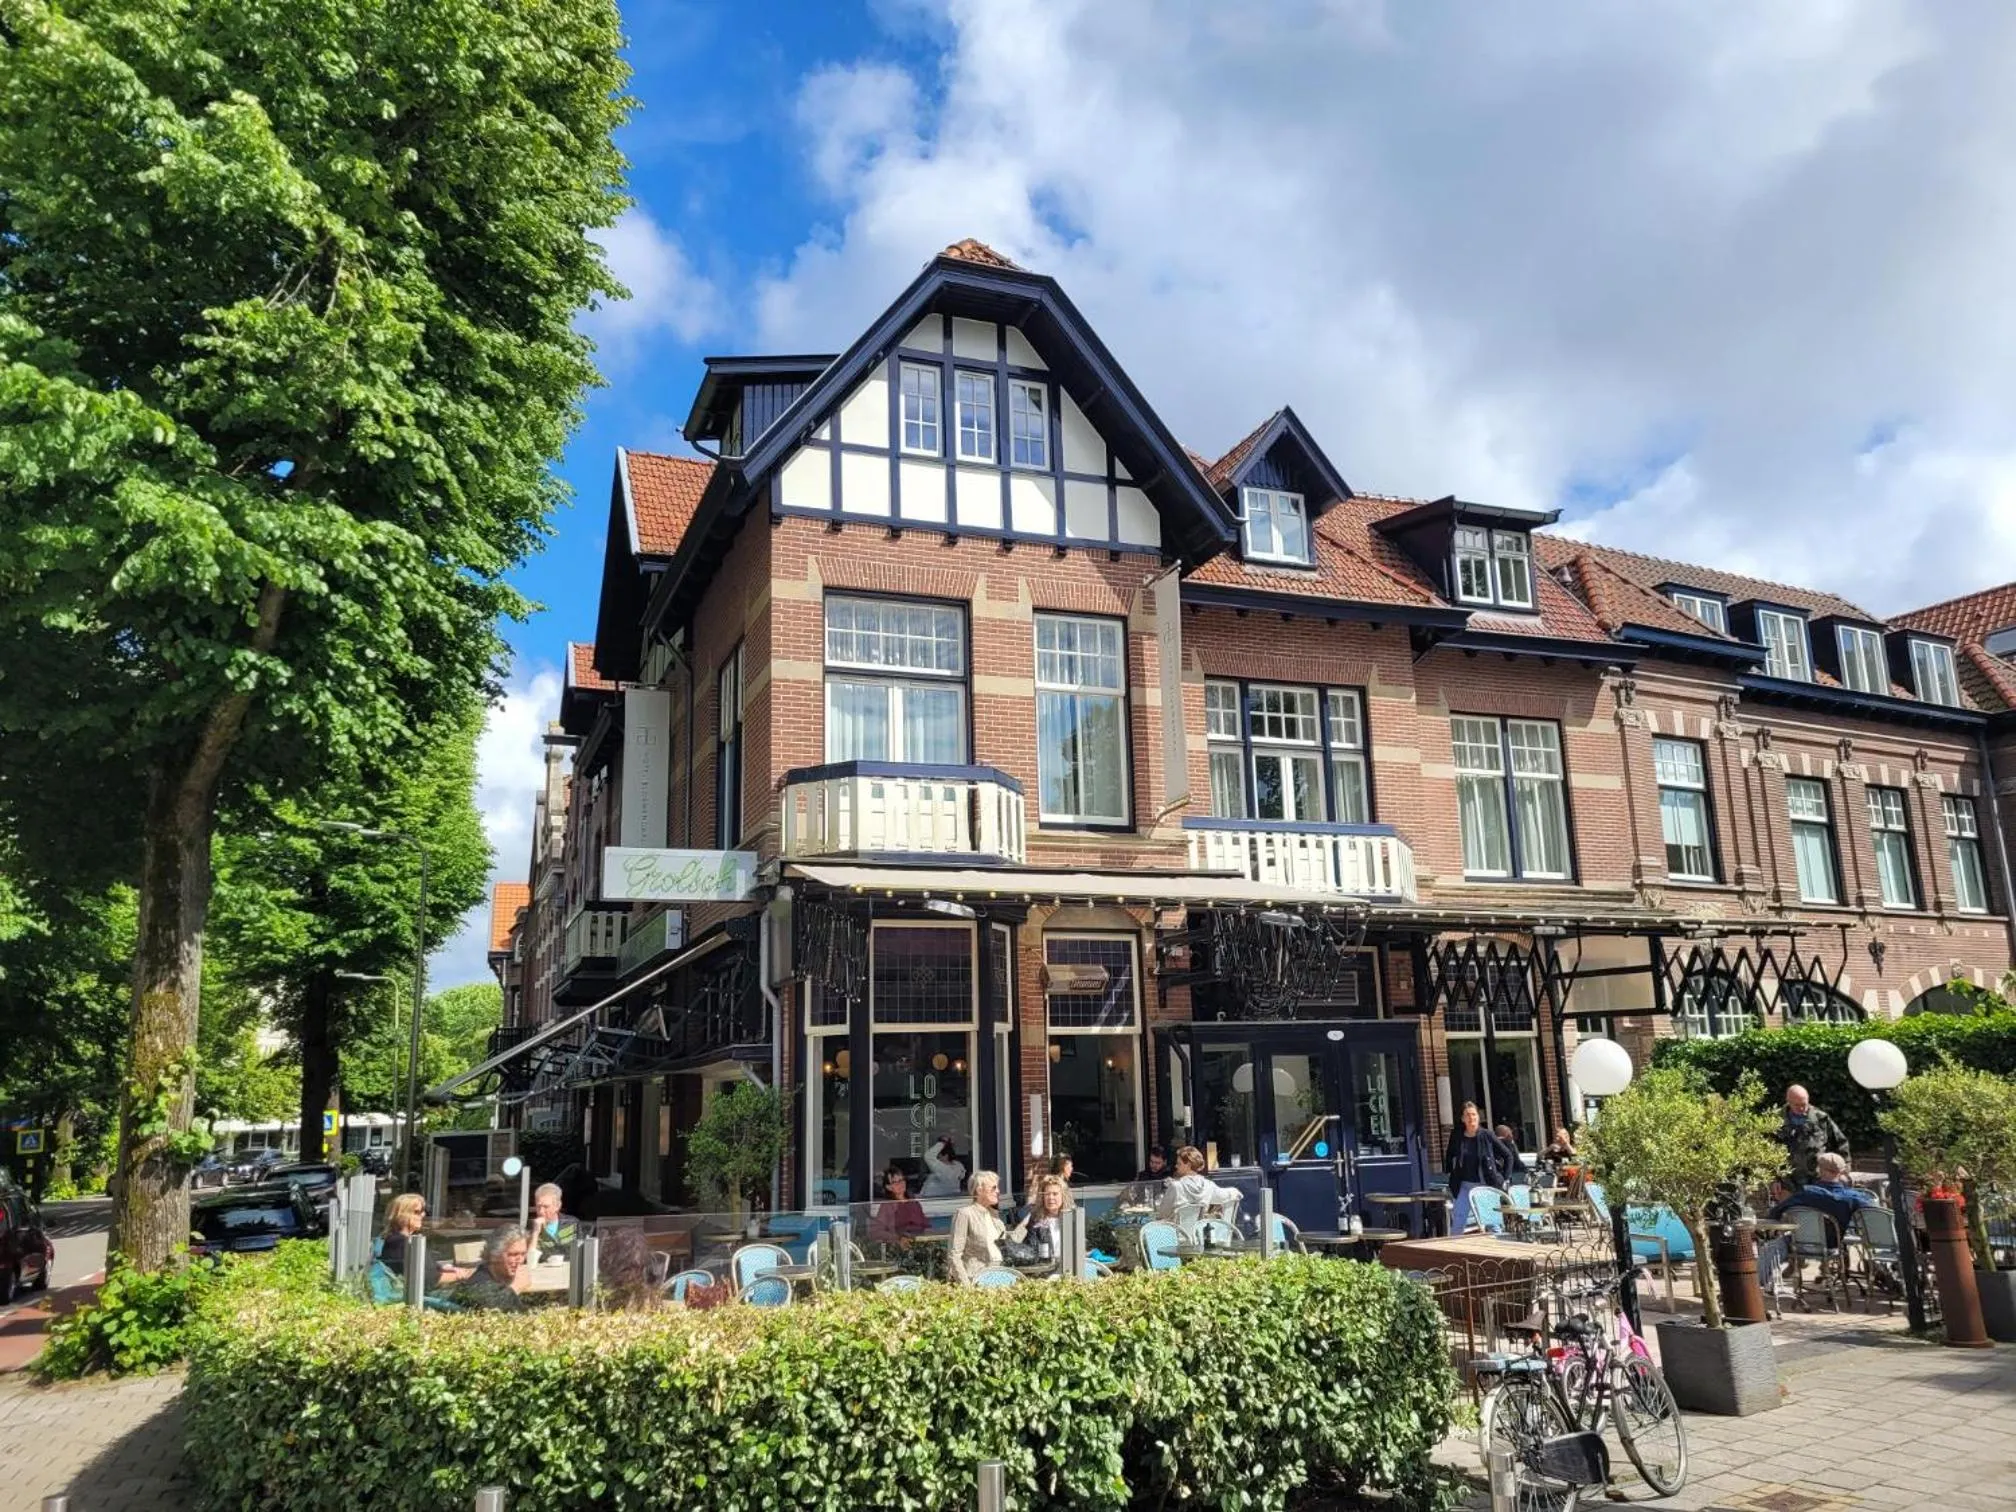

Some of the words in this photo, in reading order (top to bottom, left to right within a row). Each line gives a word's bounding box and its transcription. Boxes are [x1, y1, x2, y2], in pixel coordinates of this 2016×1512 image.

[623, 855, 738, 899] Grolsch
[909, 1073, 937, 1099] LO
[910, 1103, 937, 1128] CA
